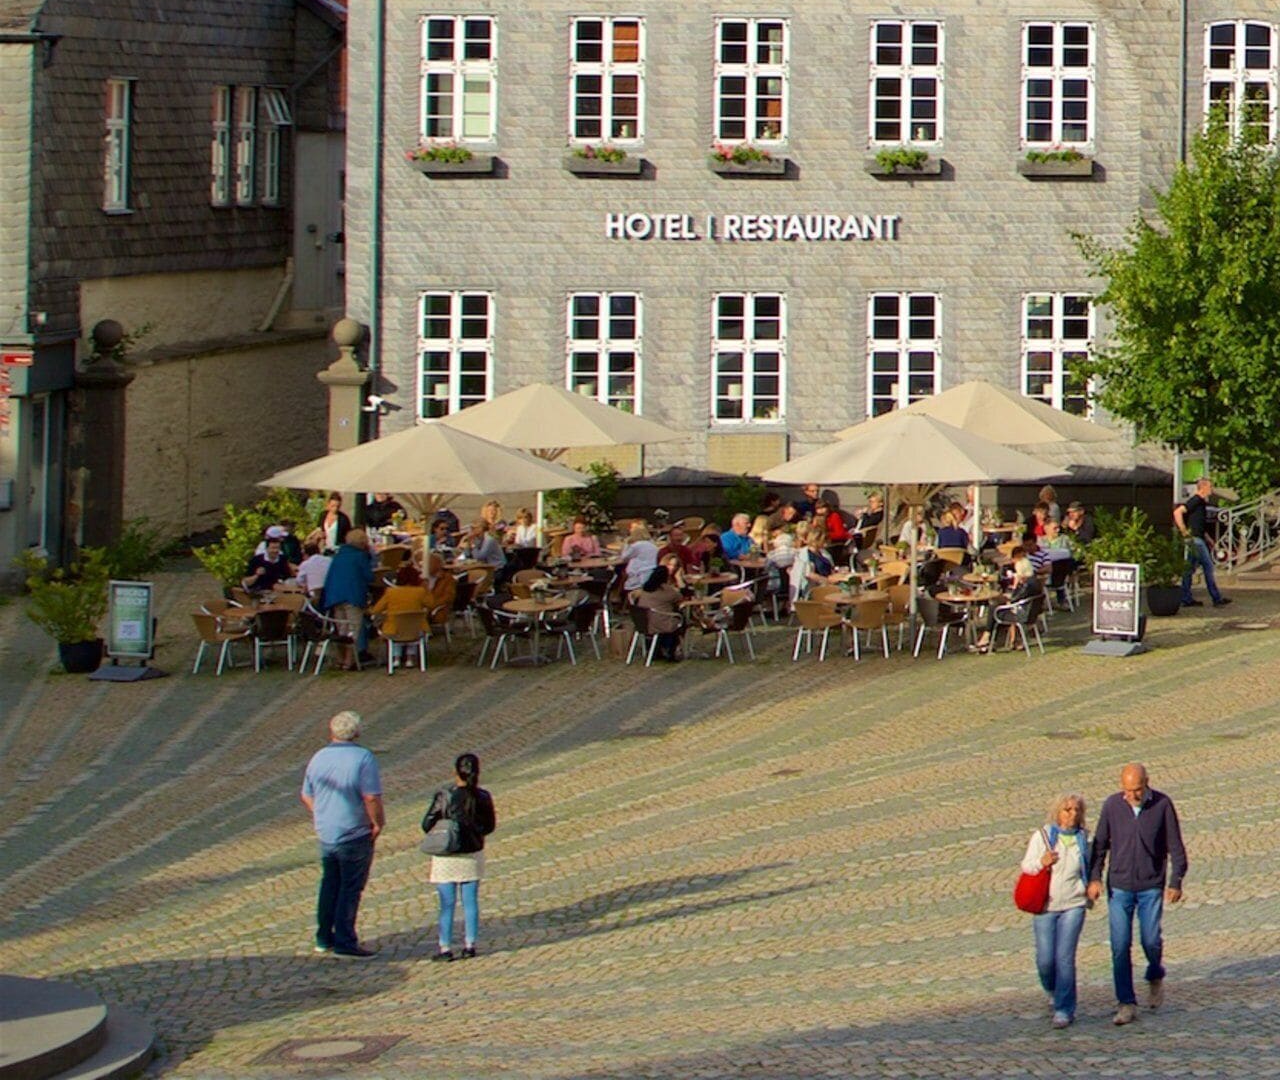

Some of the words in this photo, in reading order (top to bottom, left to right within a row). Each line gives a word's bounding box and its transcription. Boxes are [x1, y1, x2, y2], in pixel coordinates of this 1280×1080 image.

[604, 213, 700, 240] HOTEL
[723, 214, 901, 241] RESTAURANT
[1100, 568, 1134, 580] CURRY
[1100, 580, 1135, 592] WURST
